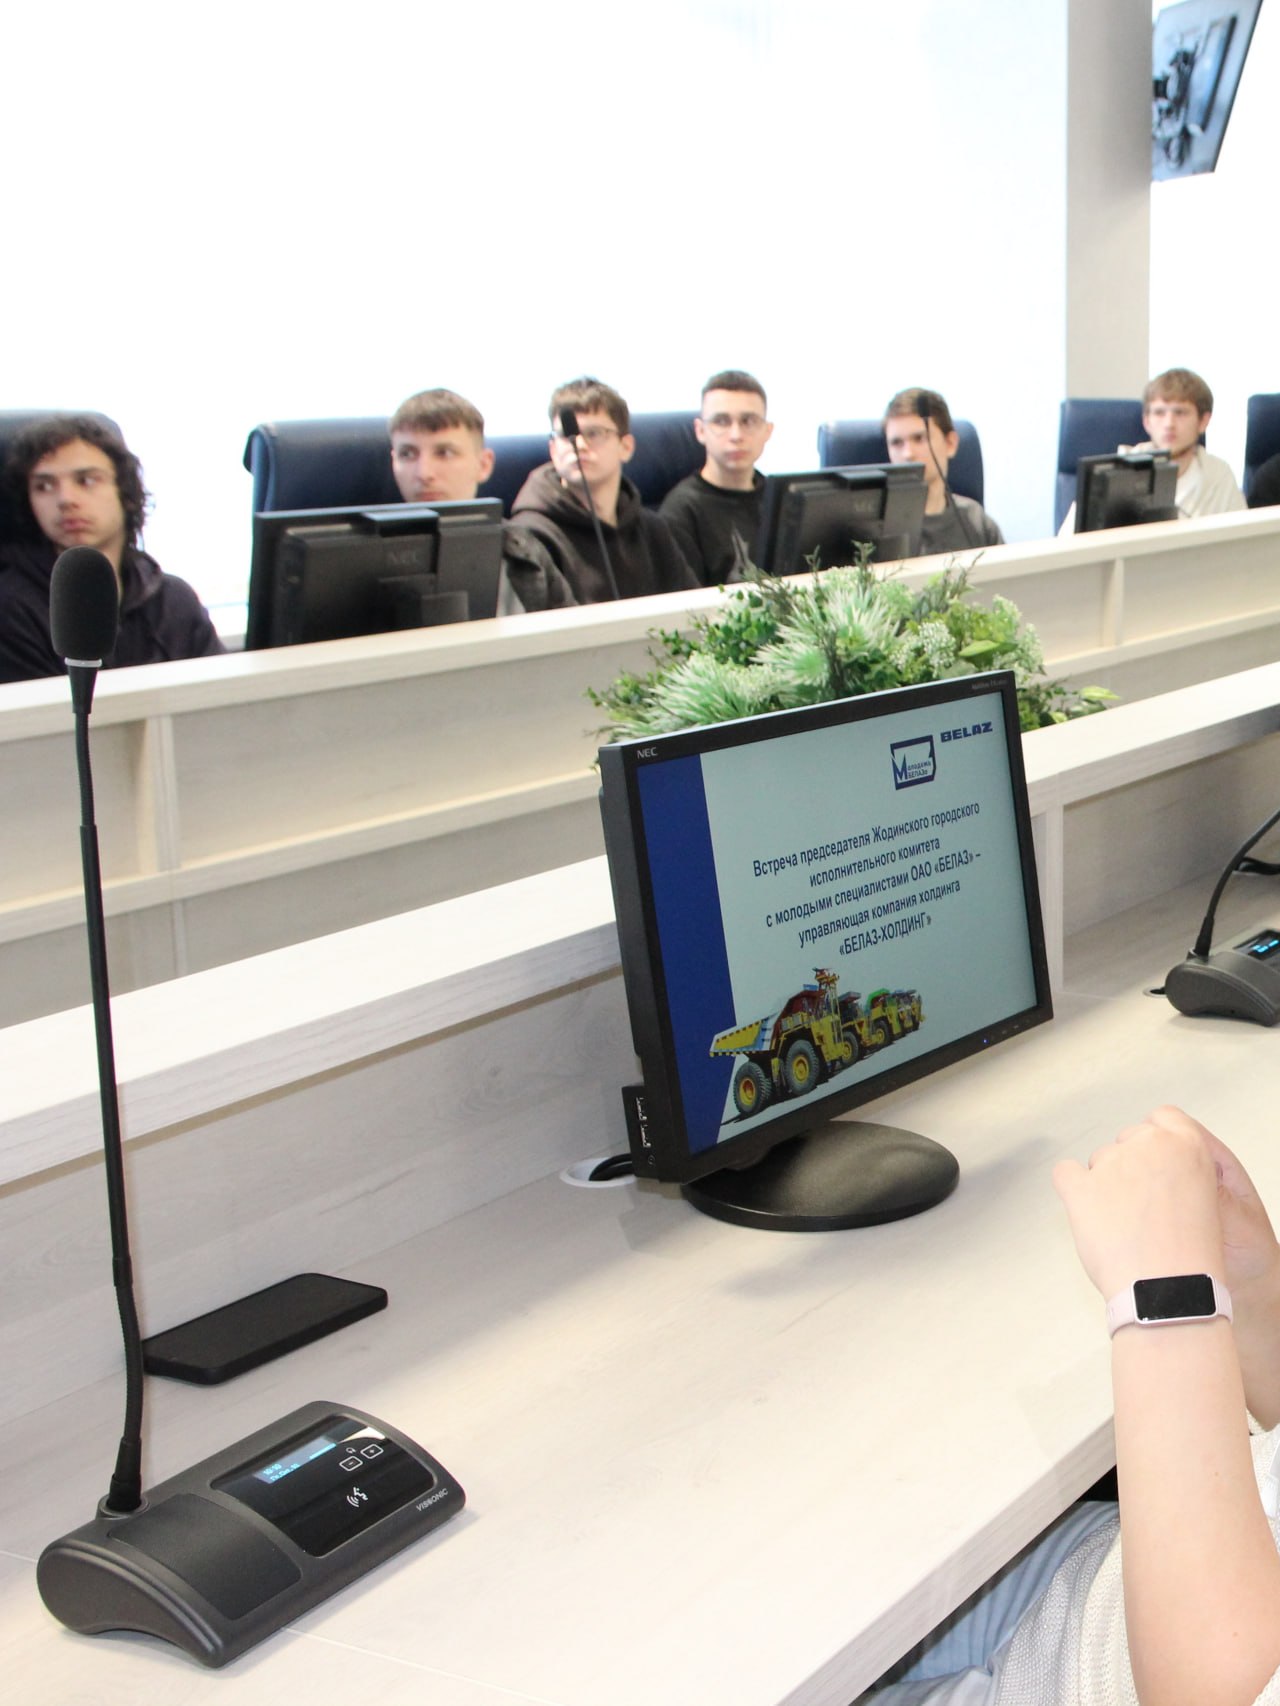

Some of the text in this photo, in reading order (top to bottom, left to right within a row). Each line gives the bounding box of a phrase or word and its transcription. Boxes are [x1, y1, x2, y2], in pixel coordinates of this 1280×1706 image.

[636, 746, 658, 759] NEC
[940, 721, 993, 743] BELAZ
[753, 802, 980, 877] Встреча председателя Жодинского городского
[809, 838, 940, 887] исполнительного комитета
[766, 914, 773, 928] с
[775, 895, 833, 926] молодыми
[834, 871, 910, 906] специалистами
[910, 861, 932, 881] ОАО
[934, 849, 974, 873] «БЕЛАЗ»
[799, 880, 961, 949] управляющая компания холдинга
[839, 911, 932, 956] «БЕЛАЗ-ХОЛДИНГ»
